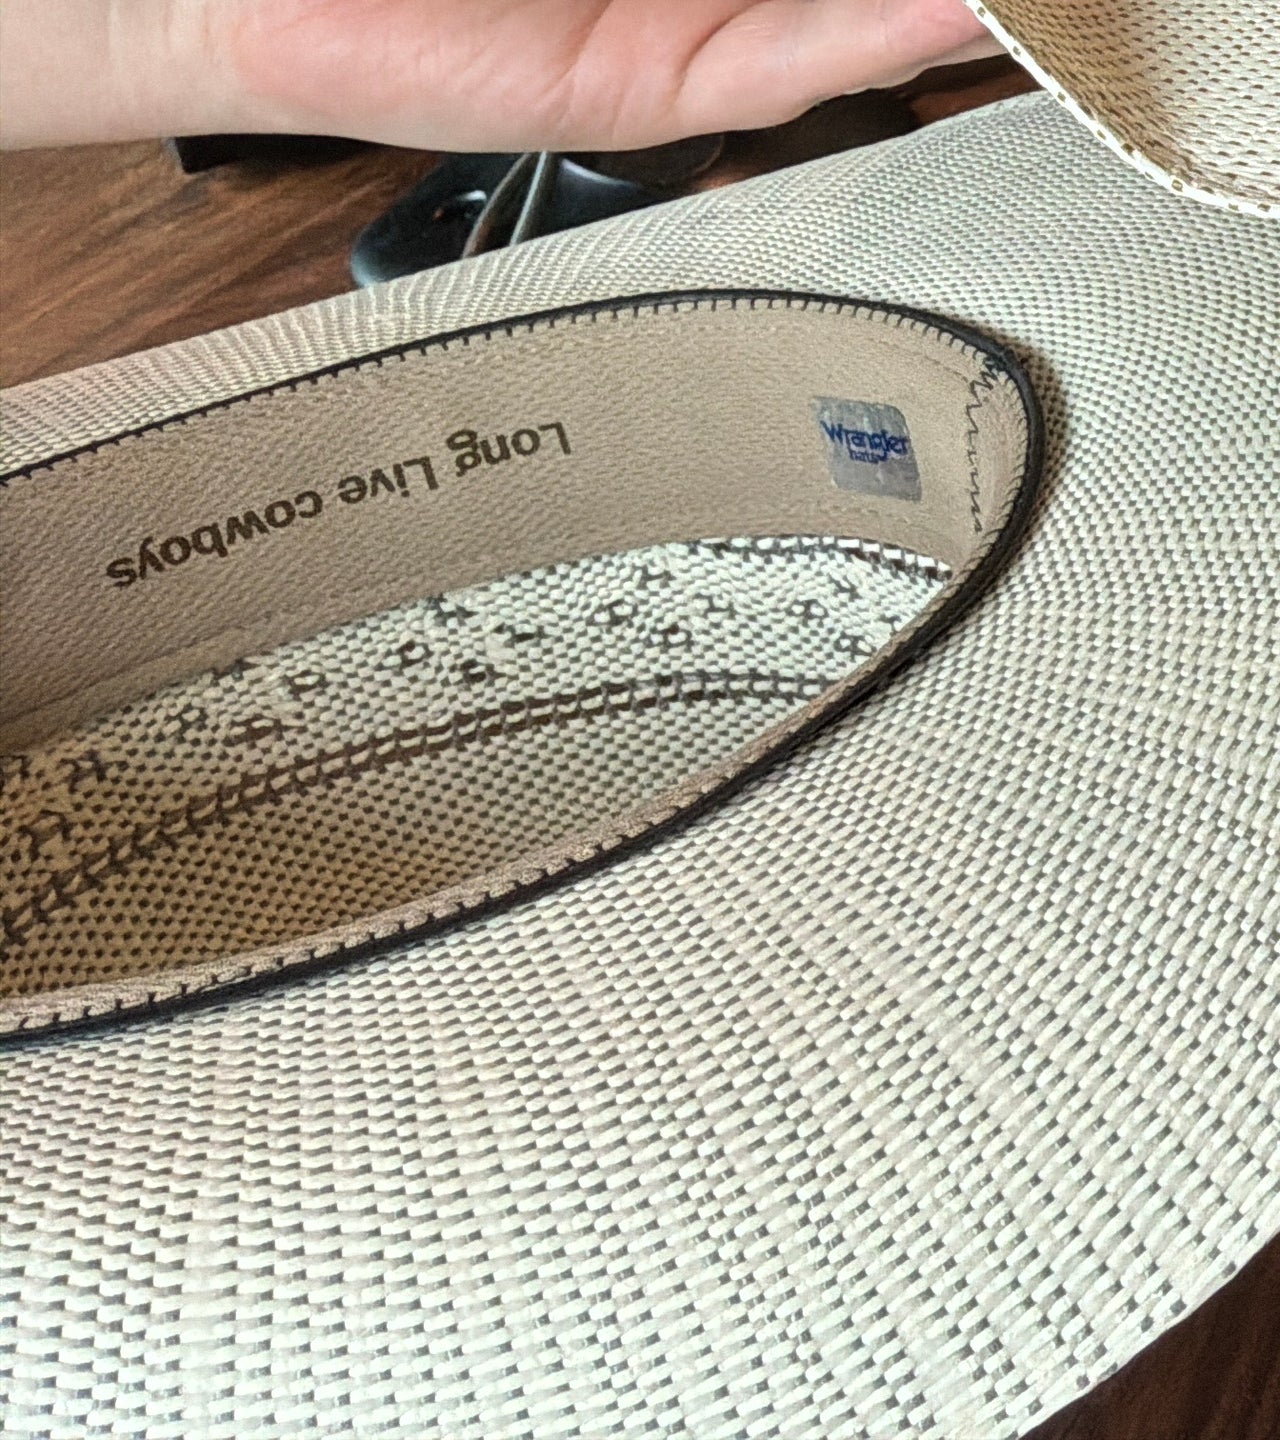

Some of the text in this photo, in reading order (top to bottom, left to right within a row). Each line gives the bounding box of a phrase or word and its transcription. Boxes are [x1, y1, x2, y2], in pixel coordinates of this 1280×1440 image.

[819, 420, 910, 461] Wrangler
[105, 422, 572, 589] Long Live cowboys
